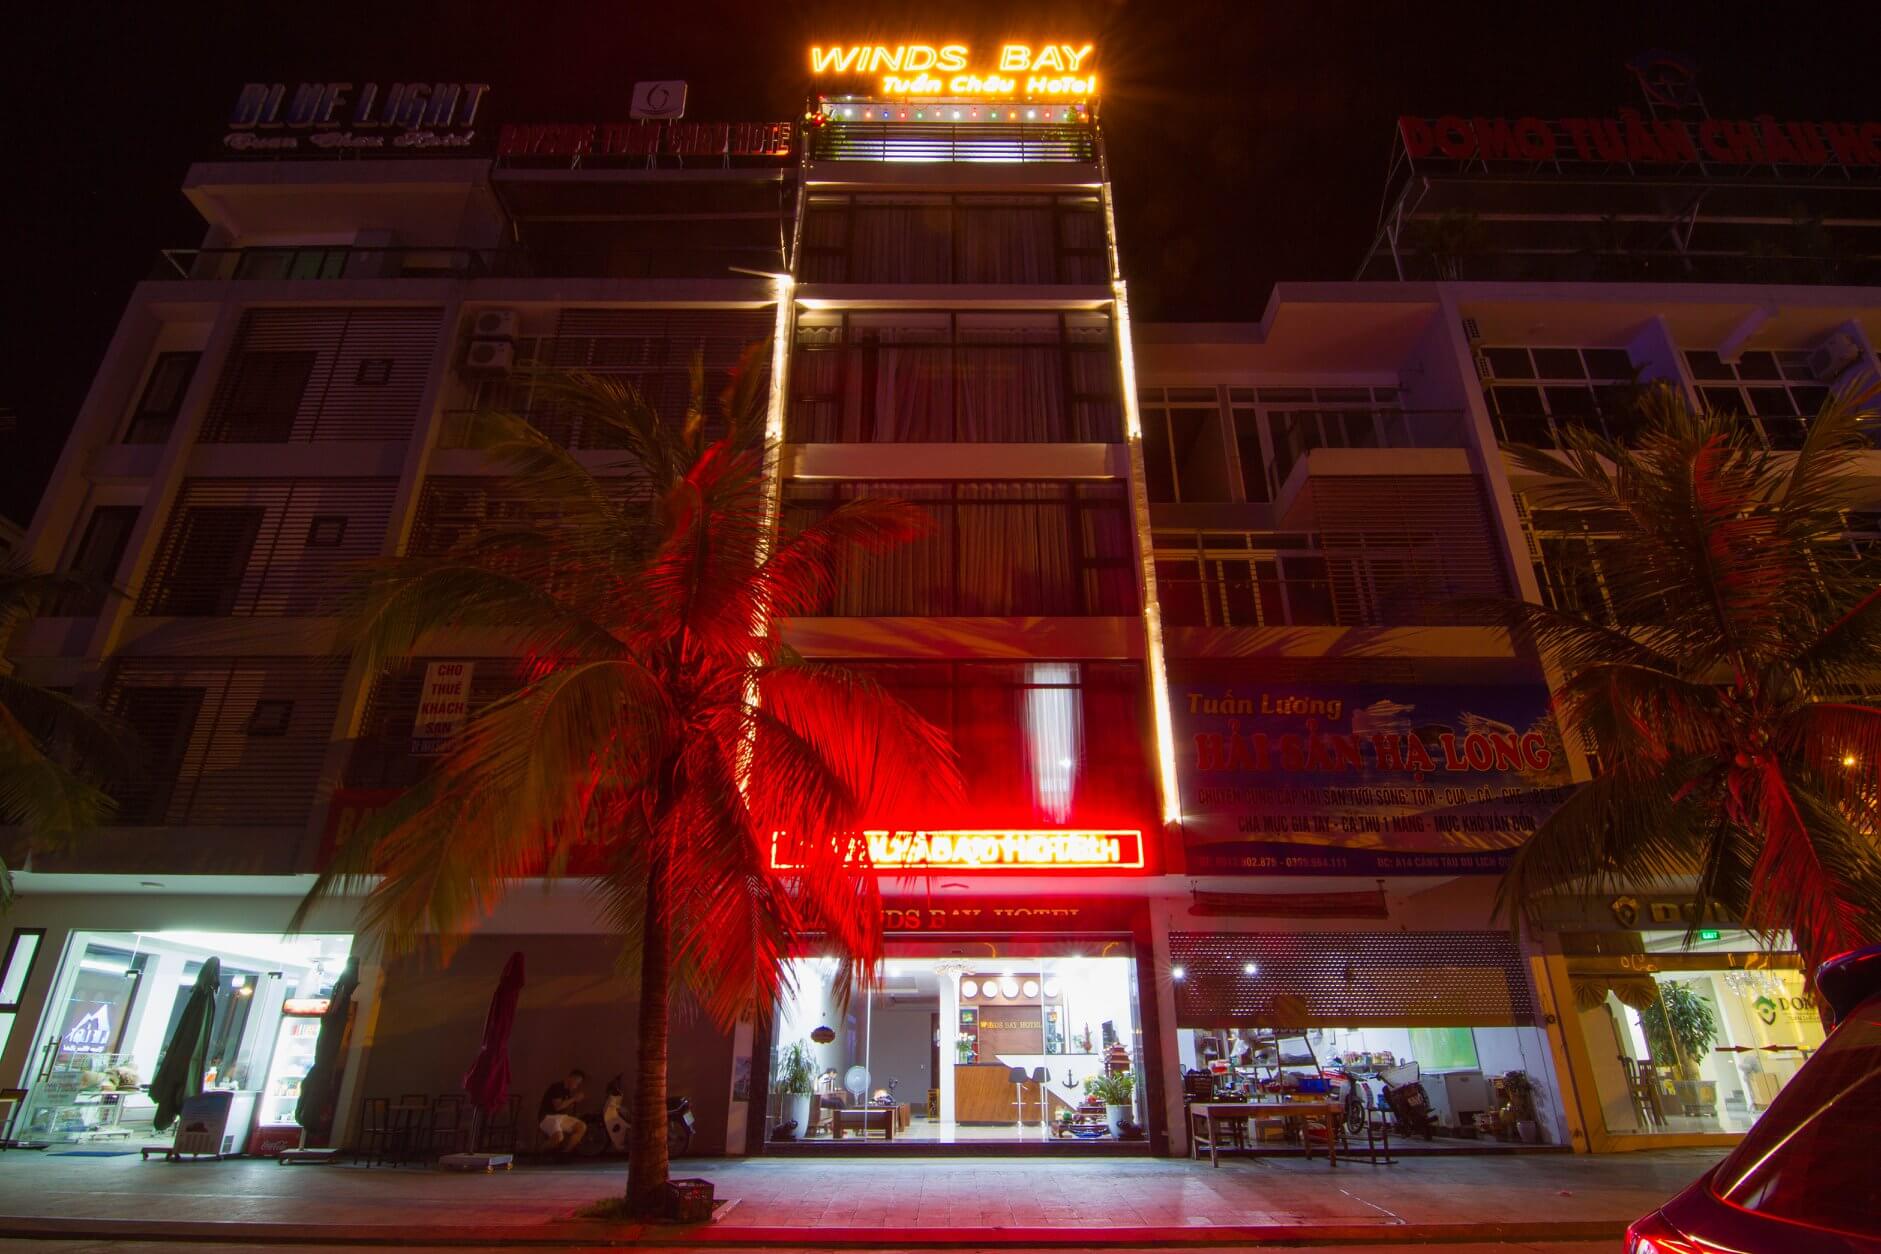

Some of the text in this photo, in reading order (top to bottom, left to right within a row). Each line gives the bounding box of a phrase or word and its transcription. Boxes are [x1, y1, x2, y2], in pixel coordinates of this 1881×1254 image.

[810, 44, 1095, 72] WINDS BAY
[351, 81, 491, 130] LIGHT
[1400, 112, 1552, 159] DOMO
[438, 664, 463, 676] CHO
[1371, 732, 1436, 783] HẠ
[1438, 731, 1552, 772] LONG
[1445, 786, 1469, 806] CUA
[1358, 815, 1380, 833] THU
